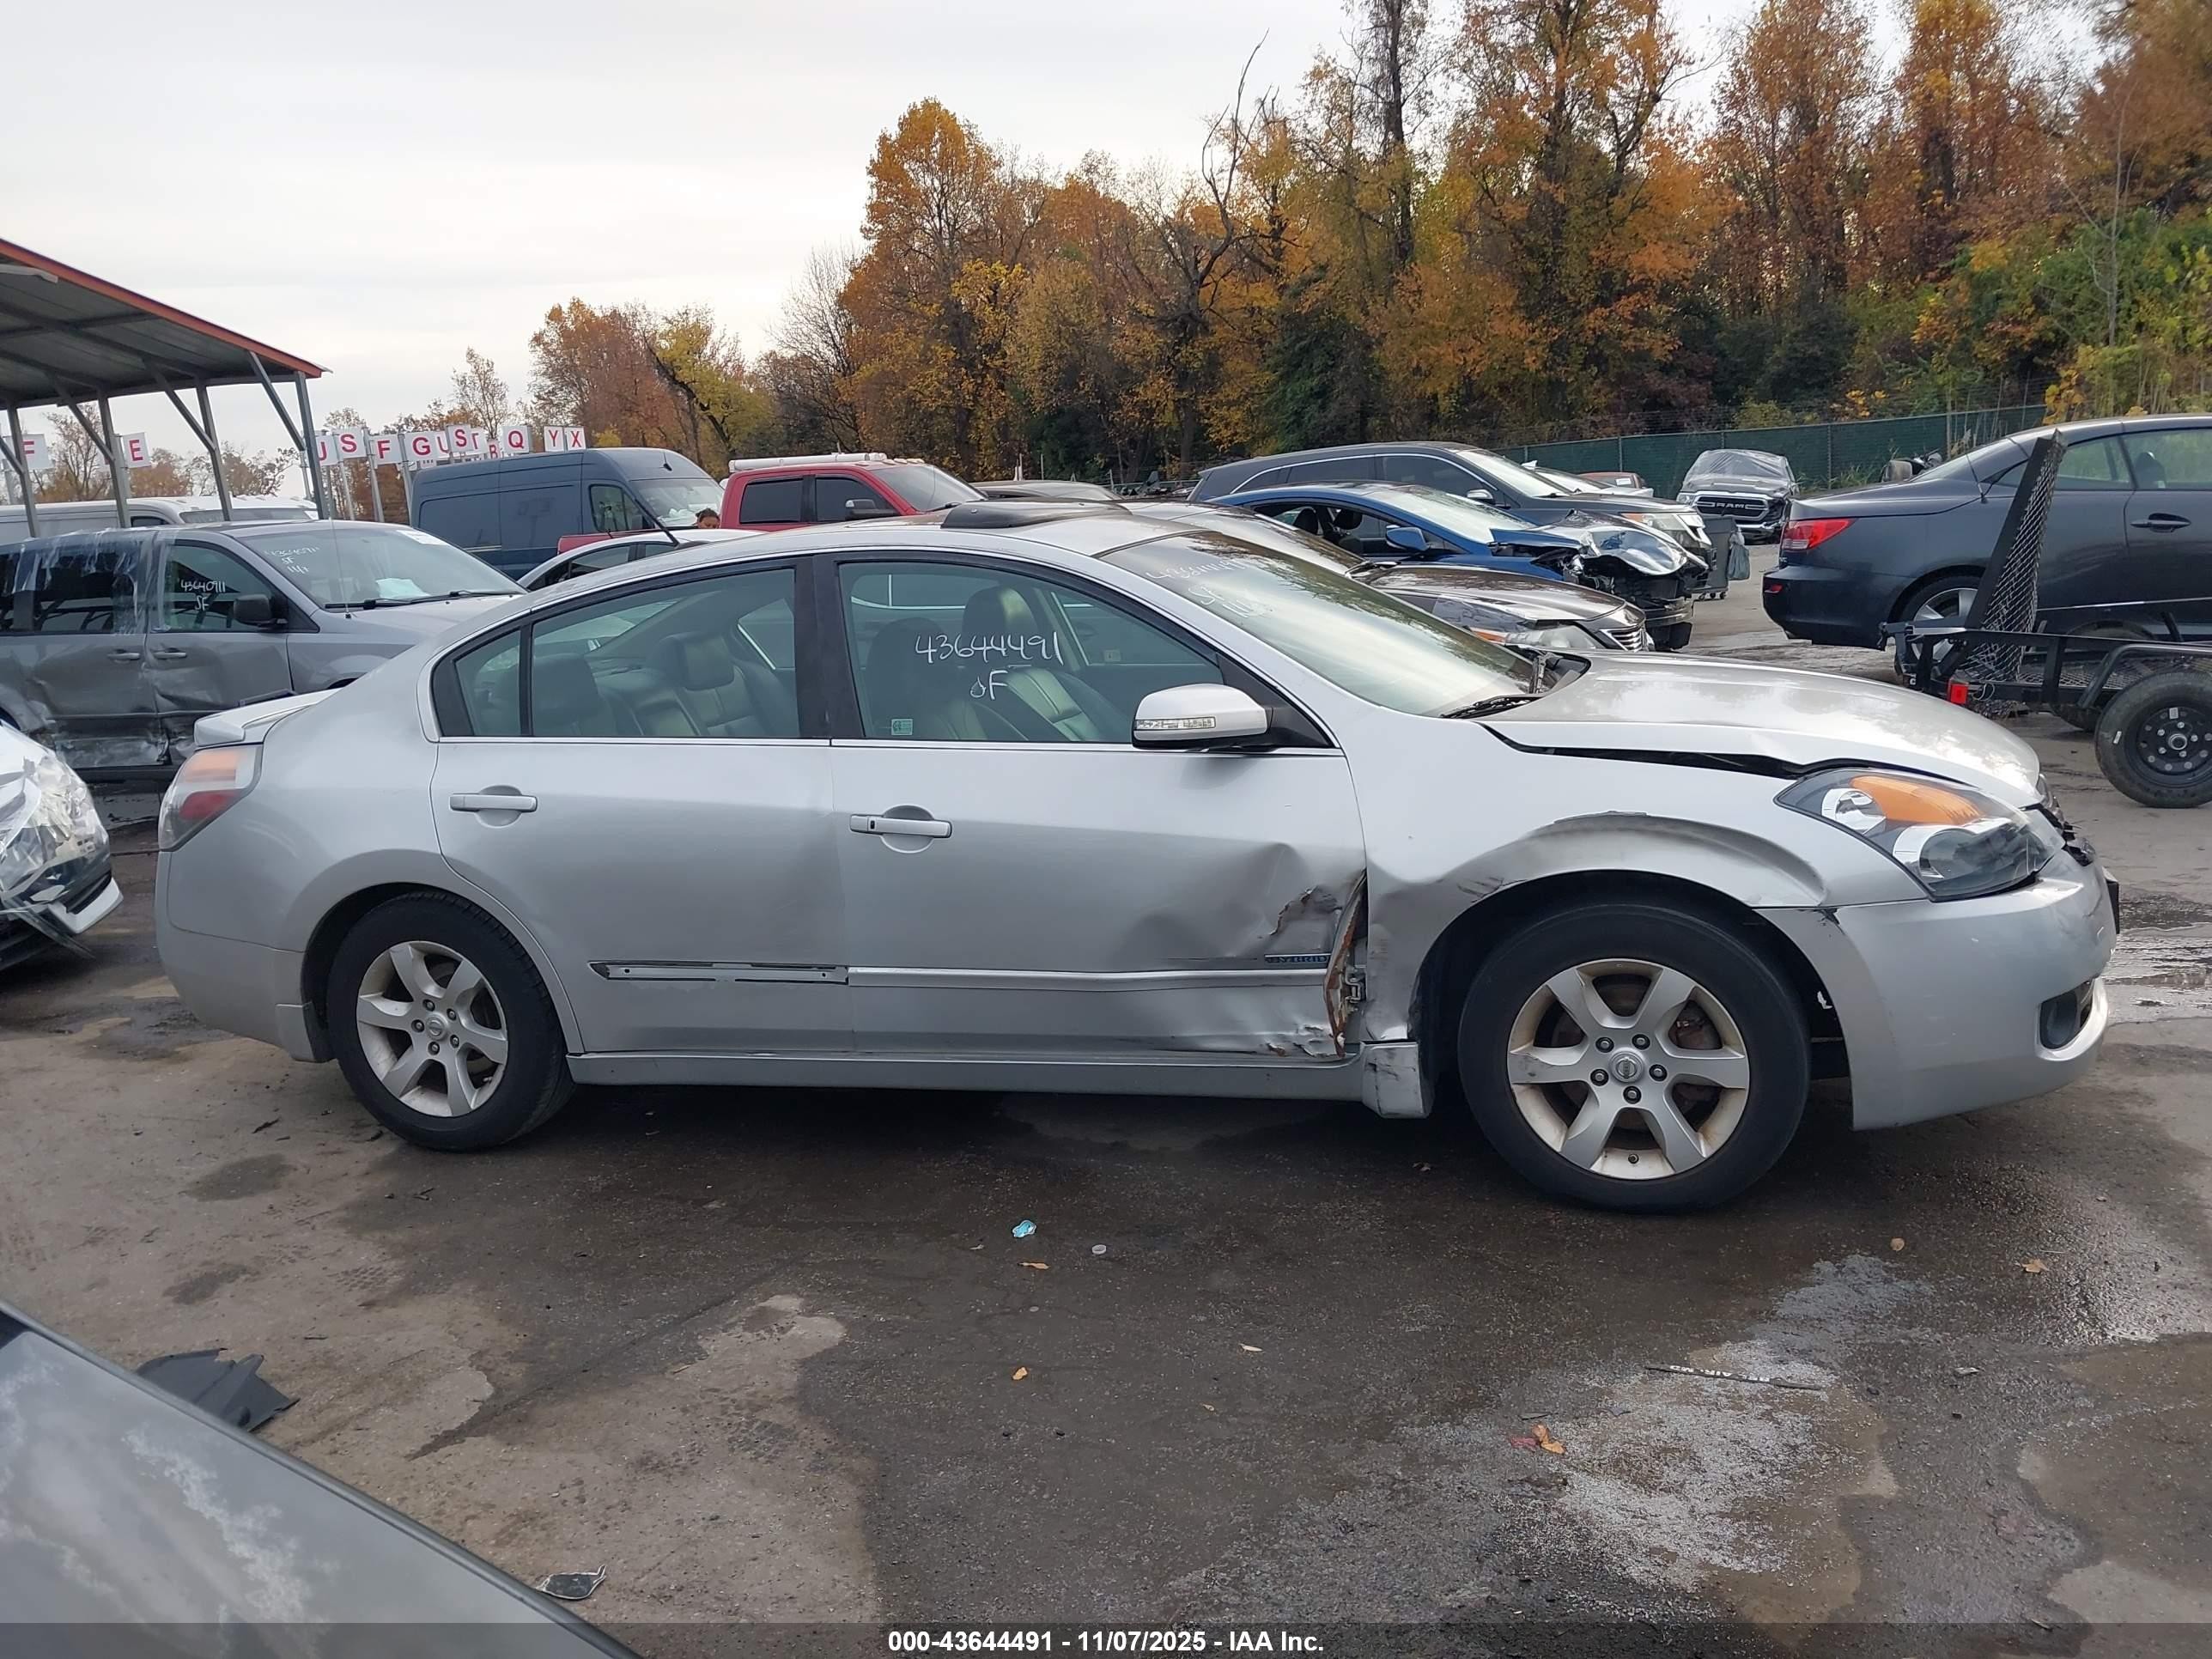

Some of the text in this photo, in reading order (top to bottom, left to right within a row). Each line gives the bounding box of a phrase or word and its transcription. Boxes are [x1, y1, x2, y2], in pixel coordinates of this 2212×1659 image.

[340, 434, 357, 453] S
[412, 436, 432, 456] G
[454, 428, 467, 447] S
[507, 430, 525, 449] Q
[549, 429, 558, 447] Y
[570, 430, 582, 448] X
[129, 439, 144, 462] E
[319, 441, 327, 461] J
[378, 439, 391, 459] F
[915, 631, 1064, 666] 43644491
